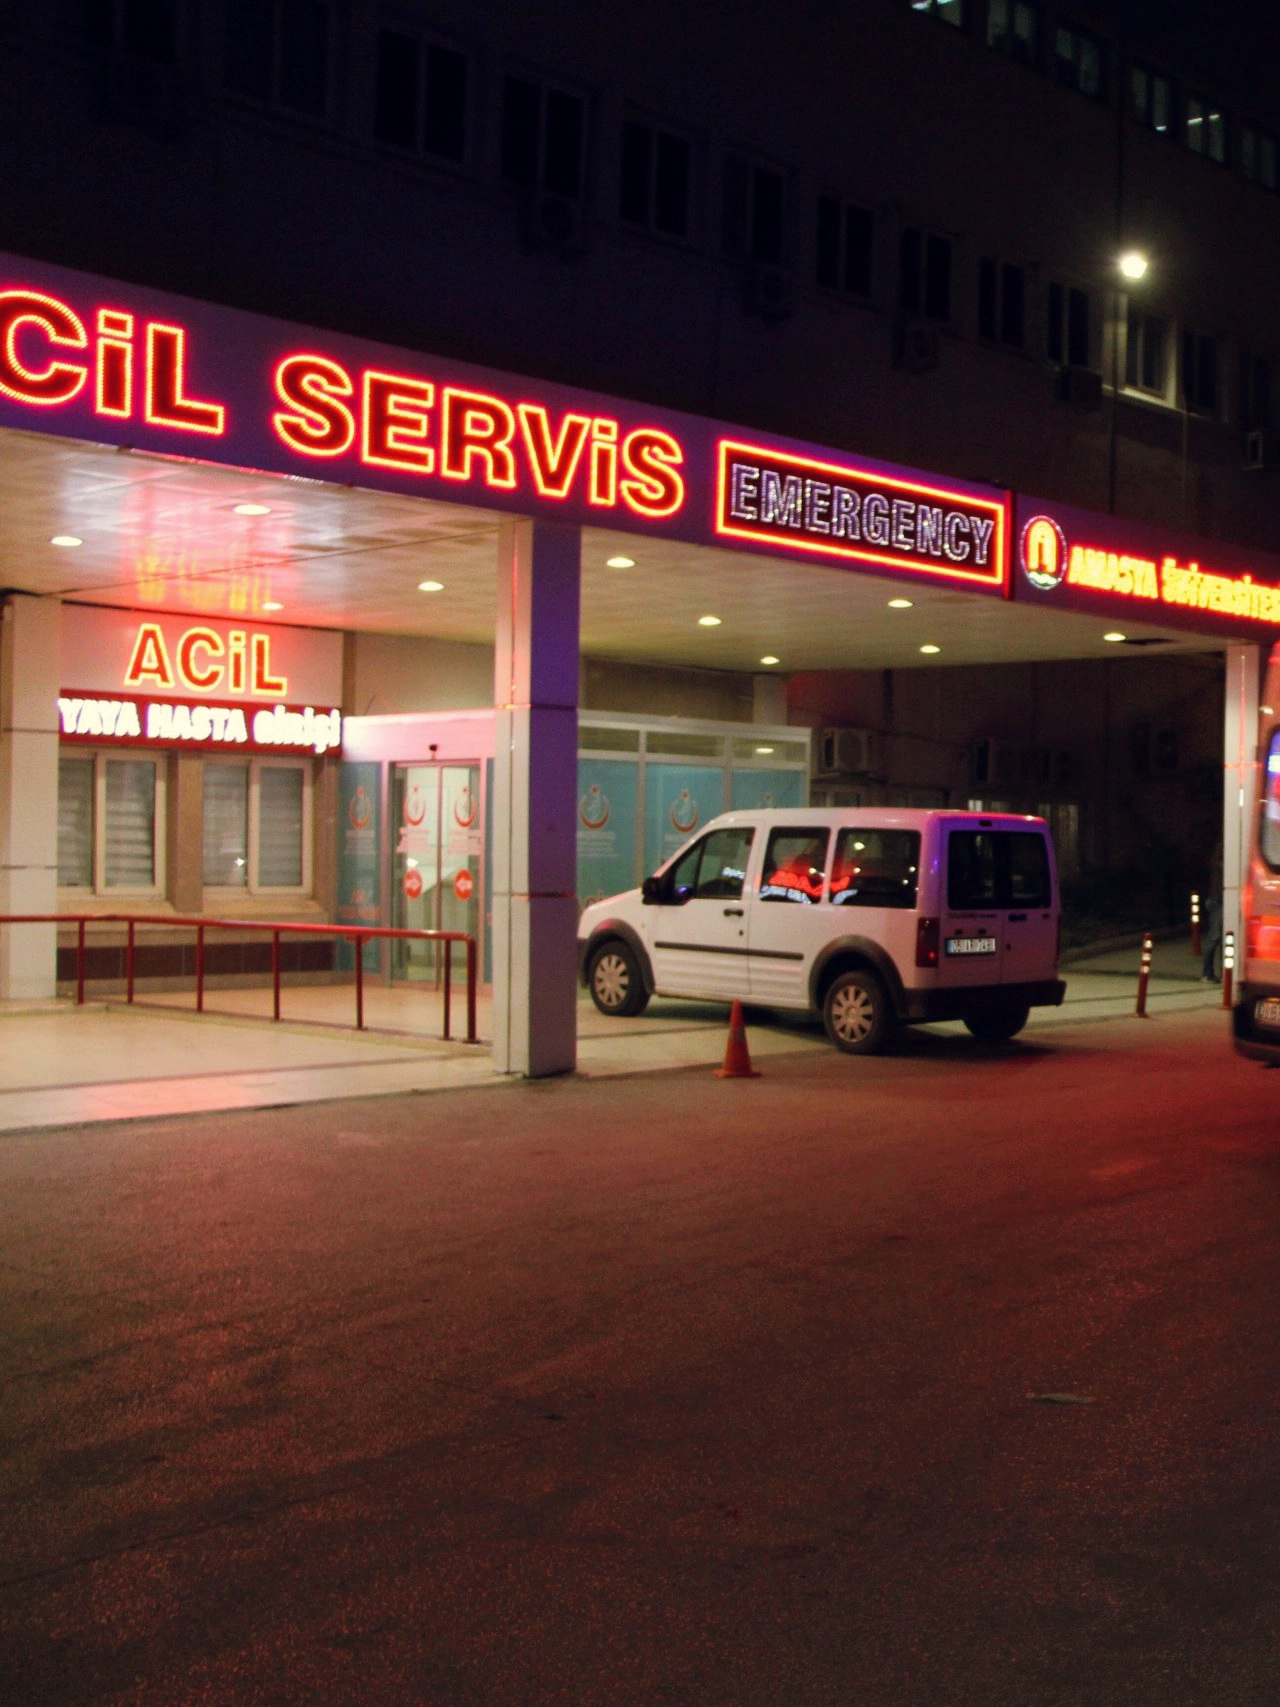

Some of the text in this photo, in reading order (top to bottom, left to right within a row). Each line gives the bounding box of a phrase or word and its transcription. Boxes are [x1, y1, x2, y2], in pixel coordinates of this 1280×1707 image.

[730, 462, 995, 565] EMERGENCY
[57, 697, 141, 737] YAYA
[147, 703, 248, 743] HASTA
